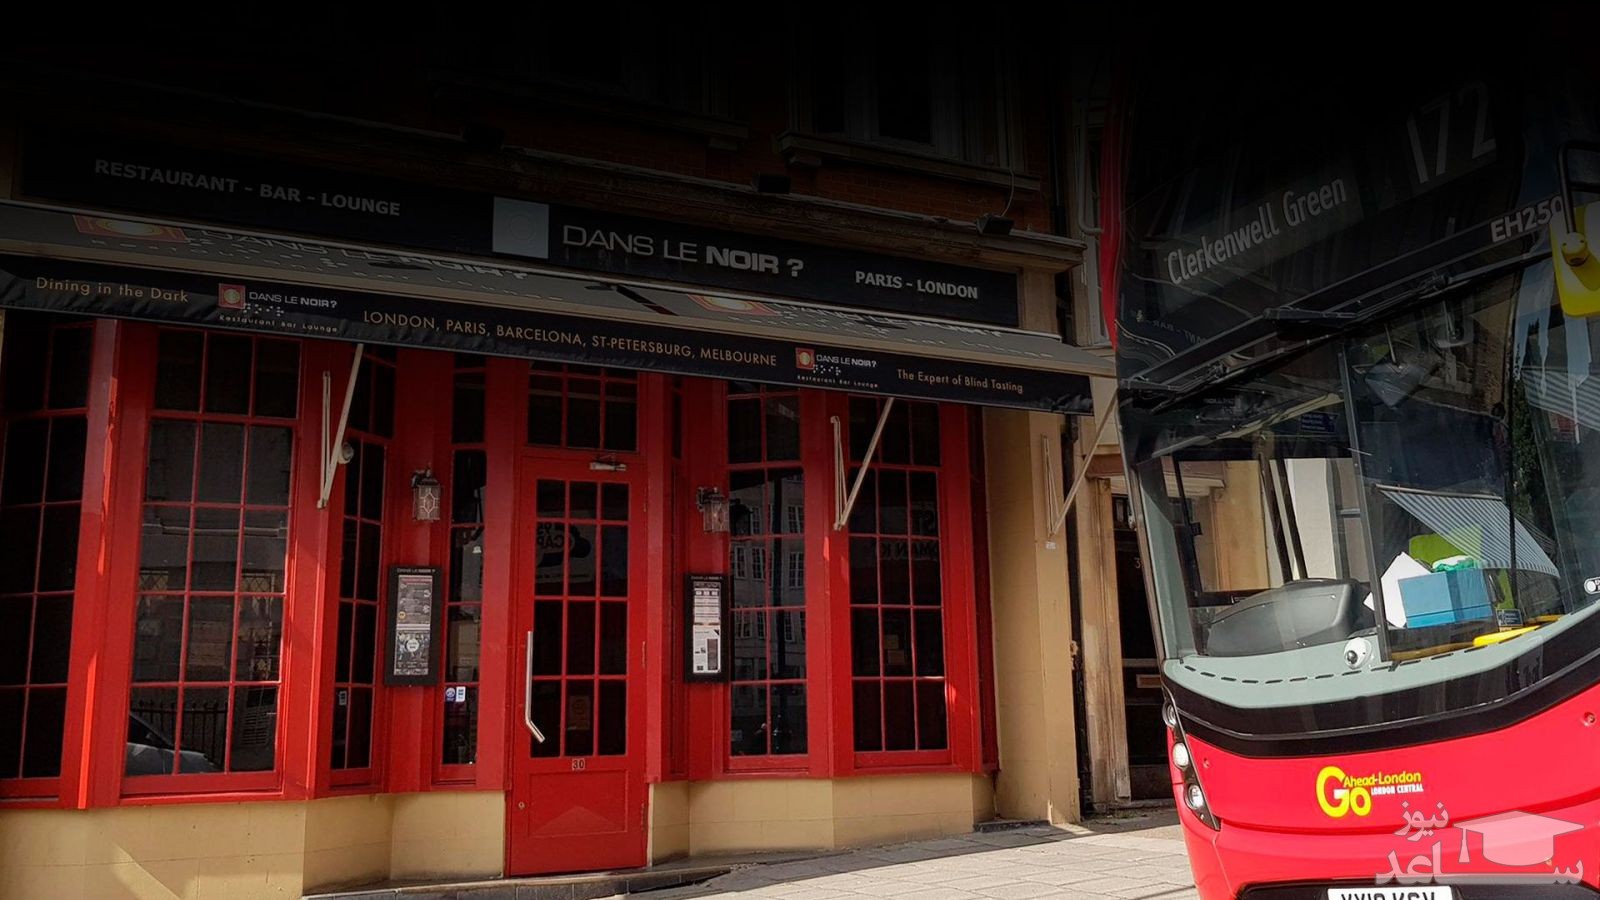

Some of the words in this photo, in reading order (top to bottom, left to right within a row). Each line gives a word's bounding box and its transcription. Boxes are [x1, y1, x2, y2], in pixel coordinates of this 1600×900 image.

[1406, 80, 1497, 184] 172
[95, 159, 239, 193] RESTAURANT
[260, 184, 301, 202] BAR
[321, 191, 401, 217] LOUNGE
[1167, 211, 1281, 285] Clerkenwell
[1283, 179, 1347, 227] Green
[563, 224, 654, 256] DANS
[664, 240, 698, 262] LE
[706, 245, 778, 274] NOIR
[36, 277, 91, 295] Dining
[98, 283, 112, 294] in
[119, 285, 144, 298] the
[151, 288, 189, 302] Dark
[855, 270, 902, 289] PARIS
[917, 280, 978, 299] LONDON
[249, 292, 282, 302] DANS
[285, 296, 298, 304] LE
[301, 298, 338, 309] NOIR?
[220, 315, 276, 326] Restaurant
[302, 324, 338, 333] Lounge
[363, 310, 439, 331] LONDON,
[446, 319, 490, 337] PARIS,
[496, 325, 587, 349] BARCELONA,
[592, 335, 696, 361] ST-PETERSBURG,
[700, 348, 777, 367] MELBOURNE
[816, 354, 839, 364] DANS
[840, 357, 850, 365] LE
[851, 359, 877, 369] NOIR?
[897, 369, 915, 382] The
[918, 371, 950, 386] Expert
[952, 376, 961, 386] of
[964, 377, 988, 389] Blind
[991, 381, 1024, 394] Tasting
[572, 759, 585, 769] 30
[1315, 765, 1372, 818] Go
[1343, 770, 1422, 788] Ahead-London
[1371, 785, 1396, 796] LONDON
[1396, 783, 1424, 794] CENTRAL
